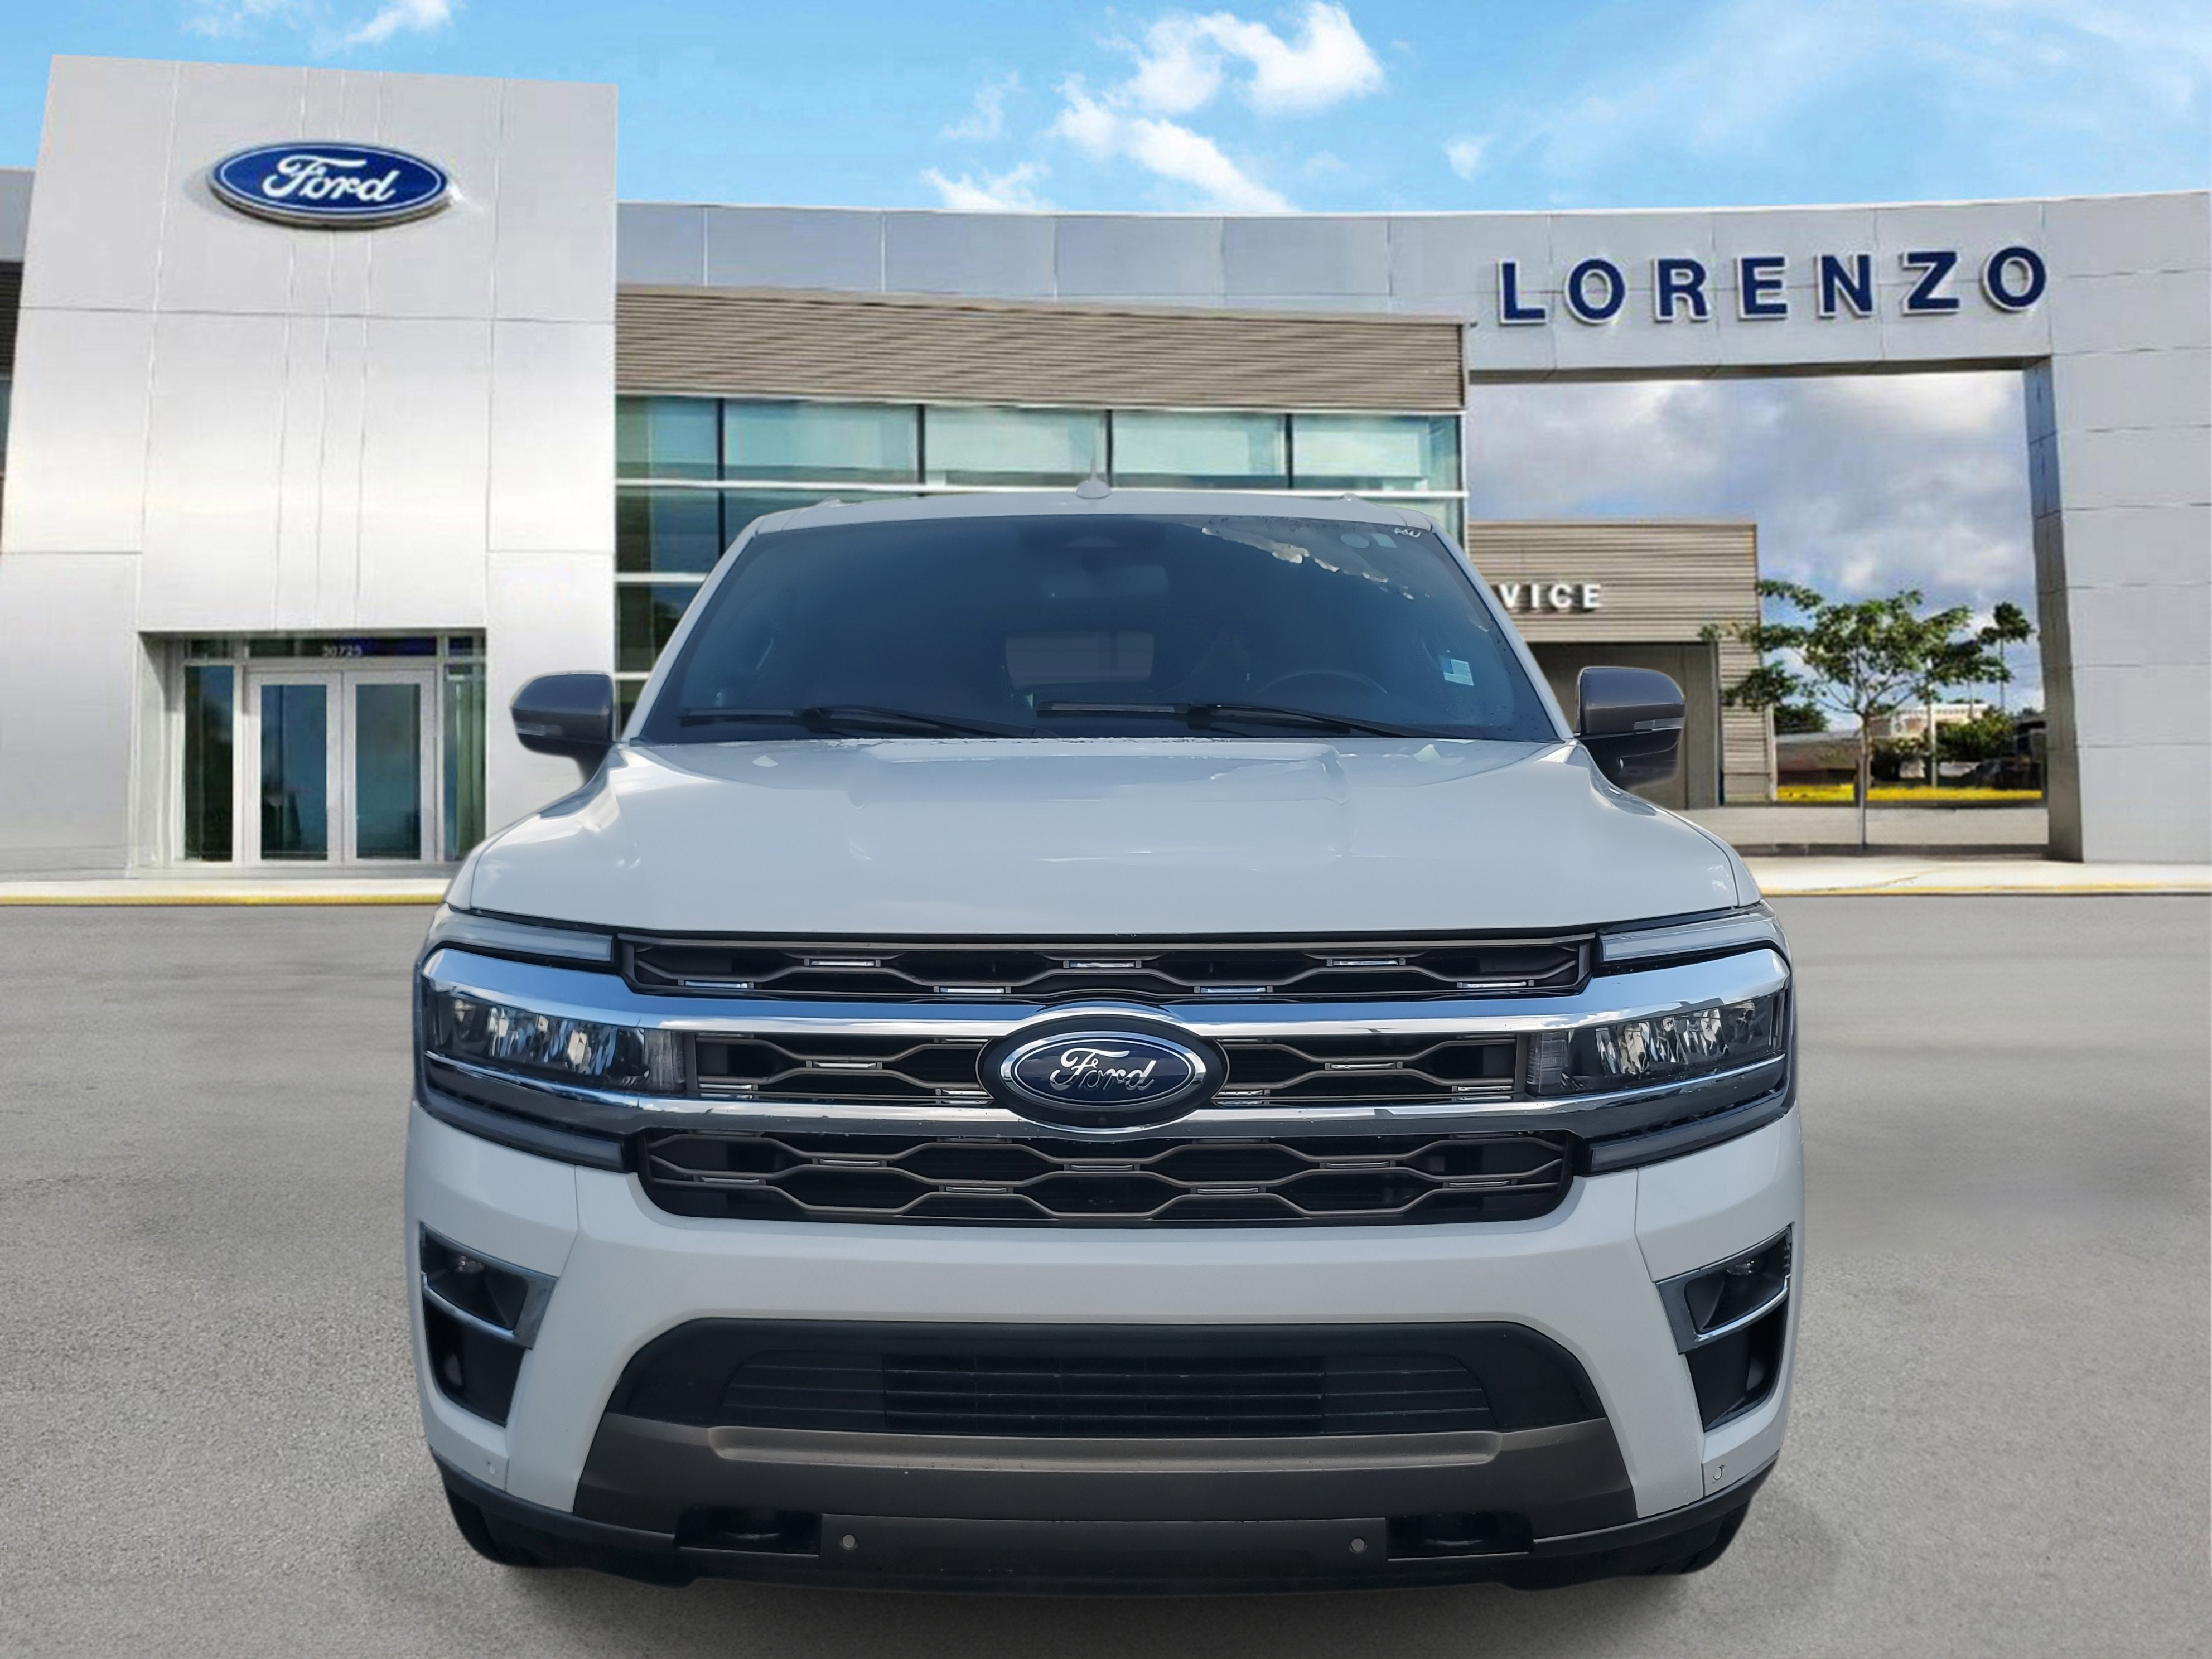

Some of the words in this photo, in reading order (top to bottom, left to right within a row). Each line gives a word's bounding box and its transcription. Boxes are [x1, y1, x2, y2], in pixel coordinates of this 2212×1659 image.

[262, 154, 401, 202] Ford
[1497, 246, 2047, 326] LORENZO
[1499, 583, 1602, 609] VICE
[1049, 1047, 1157, 1091] Ford
